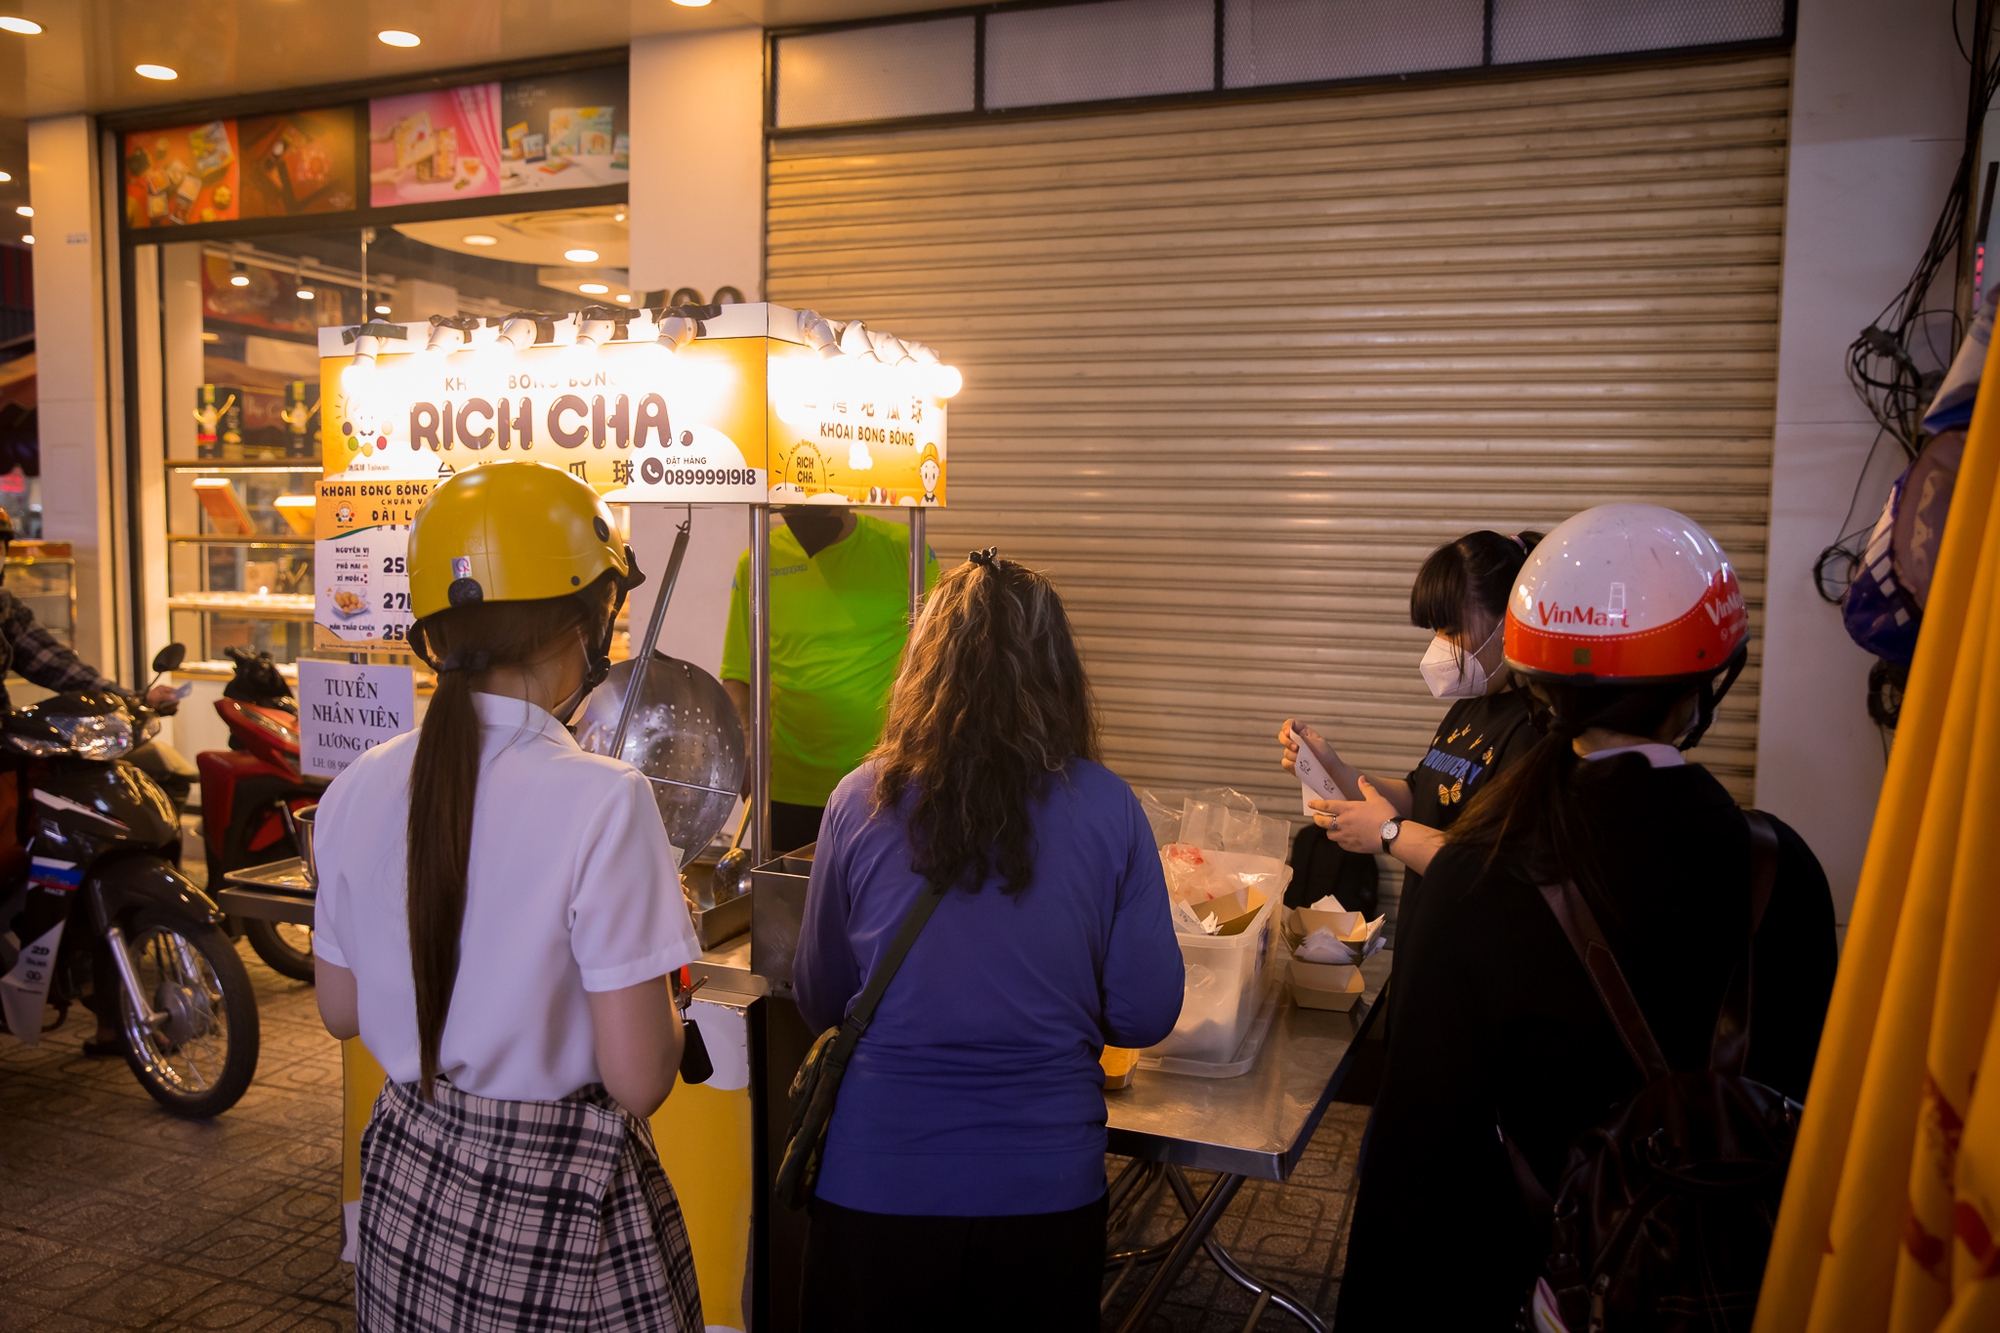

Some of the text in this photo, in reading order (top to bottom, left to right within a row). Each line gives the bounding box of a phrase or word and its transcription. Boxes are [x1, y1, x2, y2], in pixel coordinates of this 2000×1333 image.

[410, 393, 694, 451] RICH CHA.
[820, 421, 914, 446] KHOAI BONG BÓNG
[666, 455, 707, 467] ĐẶT HÀNG
[796, 456, 814, 469] RICH
[664, 469, 757, 485] 0899991918
[797, 470, 816, 483] CHA.
[321, 486, 356, 497] KHOAI
[360, 485, 392, 496] BONG
[396, 481, 428, 496] BÓNG
[372, 507, 395, 521] ĐÀI
[1538, 601, 1629, 627] VinMart
[325, 672, 378, 699] TUYỂN
[312, 702, 399, 729] NHÂN VIÊN
[318, 732, 361, 751] LƯƠNG
[312, 757, 326, 768] LH:
[327, 759, 336, 770] 08
